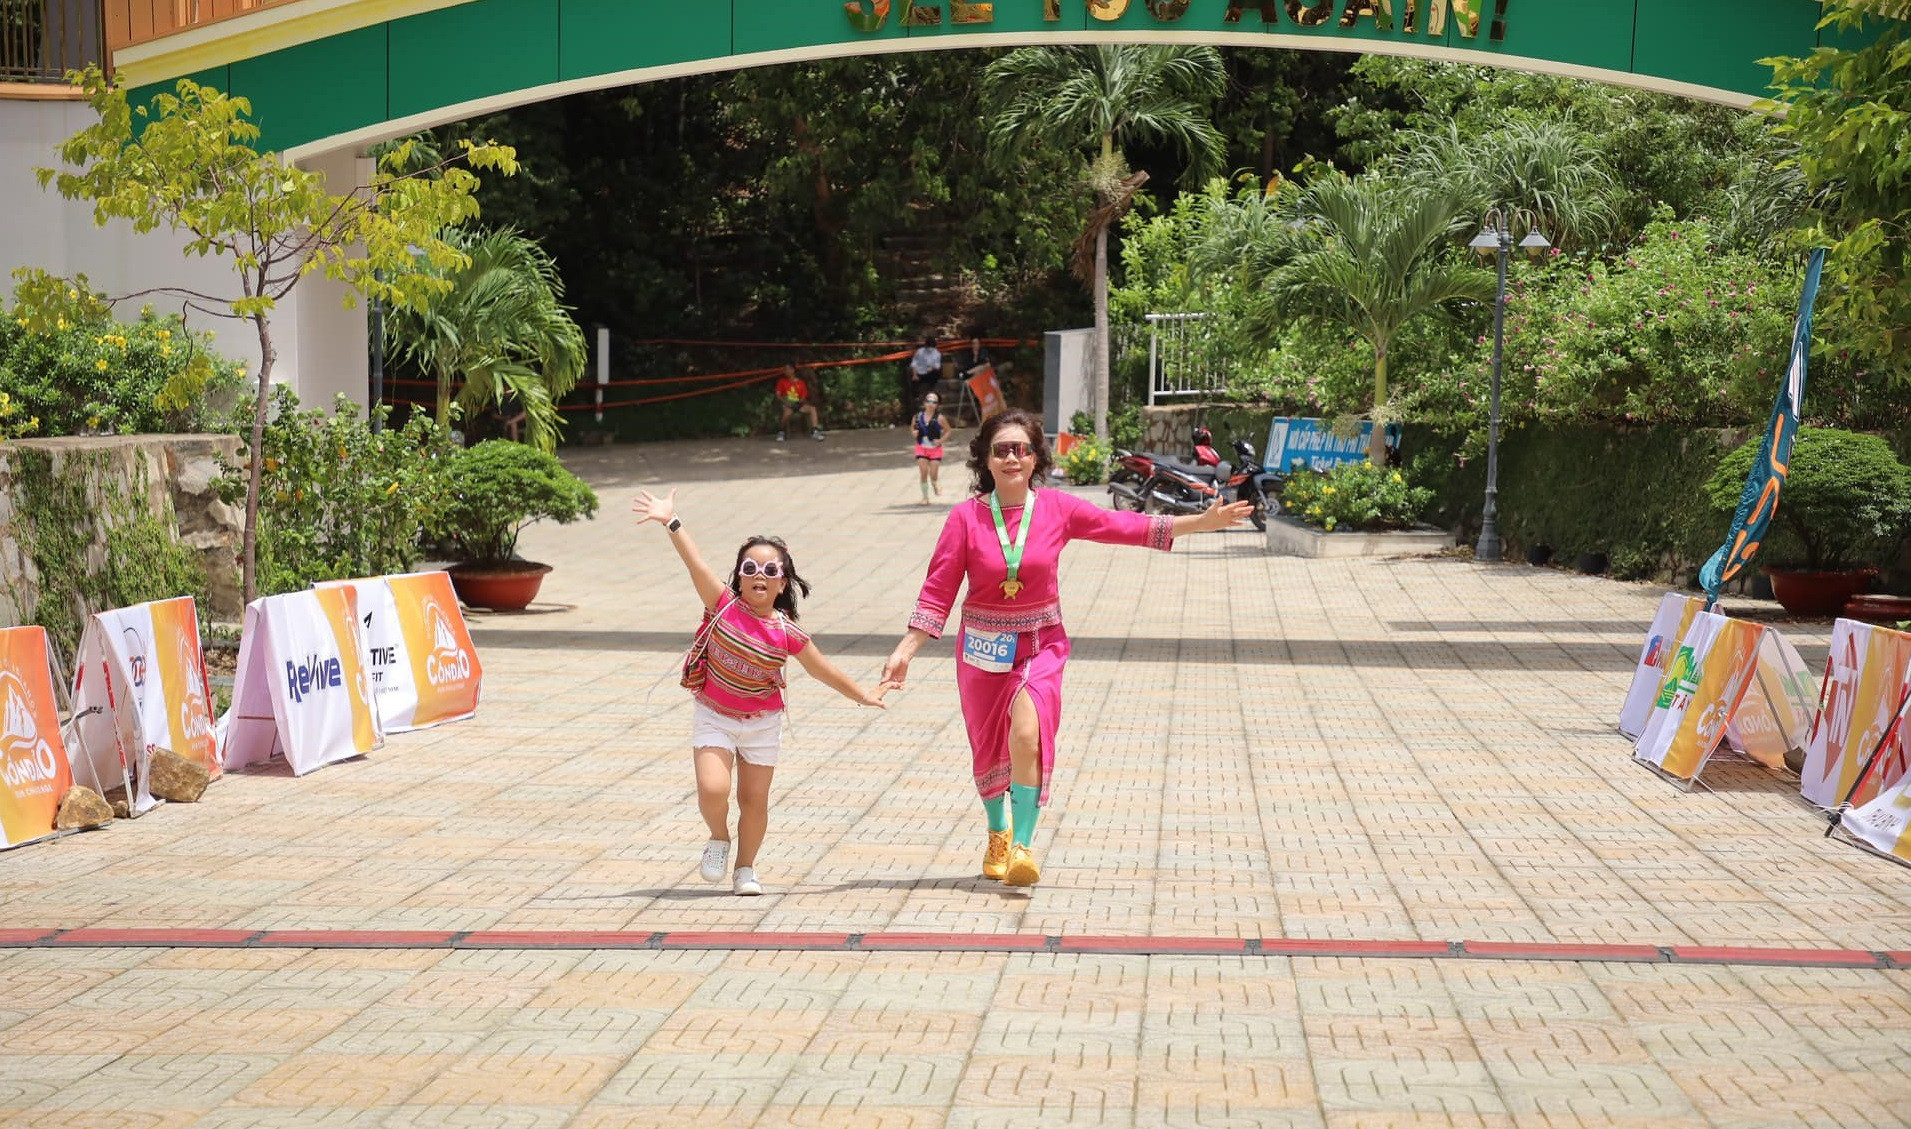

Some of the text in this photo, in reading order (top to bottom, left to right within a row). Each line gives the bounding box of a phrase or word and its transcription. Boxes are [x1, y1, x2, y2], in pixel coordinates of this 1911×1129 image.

[370, 646, 396, 666] TIVE
[967, 636, 1008, 657] 20016
[286, 654, 342, 703] ReVive
